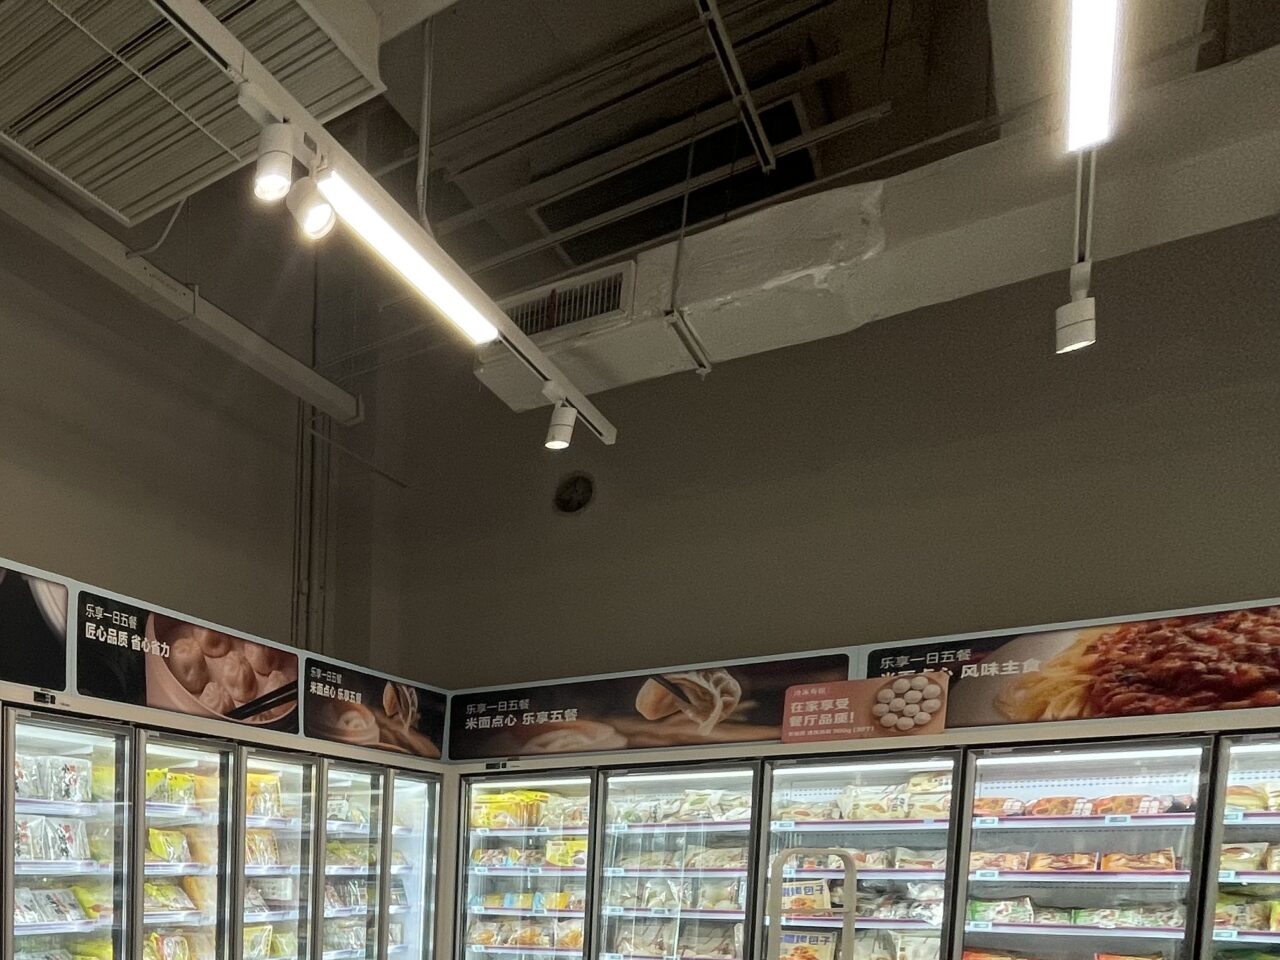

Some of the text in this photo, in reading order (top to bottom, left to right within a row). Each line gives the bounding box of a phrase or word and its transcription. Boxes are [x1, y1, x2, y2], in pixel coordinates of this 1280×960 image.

[85, 603, 138, 630] 乐享一日五餐
[85, 622, 170, 659] 匠心品质 省心省力
[880, 648, 972, 670] 乐享一日五餐
[960, 657, 1041, 679] 风味主食
[310, 666, 343, 684] 乐享一日五餐
[309, 681, 363, 705] 米面点心 乐享五餐
[466, 699, 530, 715] 乐享一日五餐
[790, 698, 850, 714] 在家享受
[465, 708, 578, 731] 米面点心 乐享五餐
